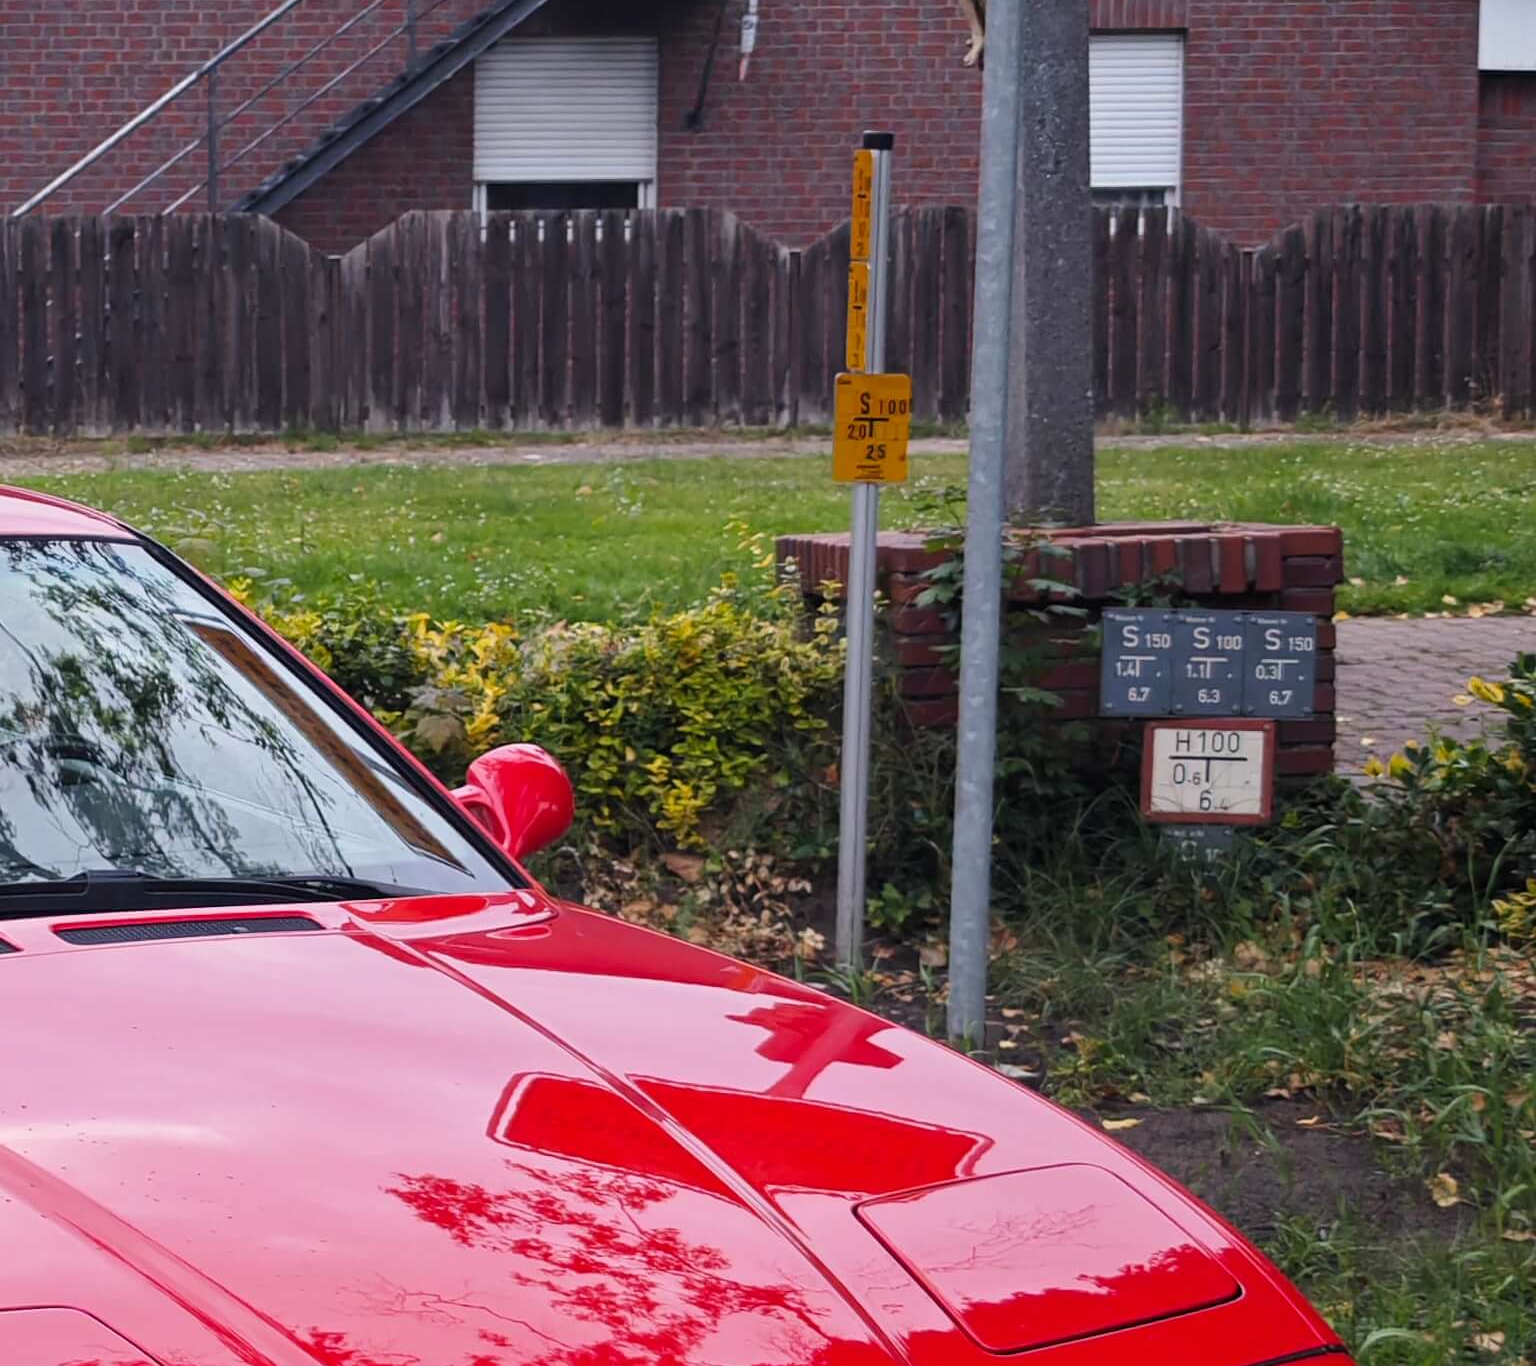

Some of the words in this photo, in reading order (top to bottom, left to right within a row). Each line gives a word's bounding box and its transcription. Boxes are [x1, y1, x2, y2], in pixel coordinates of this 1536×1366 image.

[860, 392, 870, 414] S
[1122, 625, 1140, 648] S
[1145, 633, 1171, 649] 150
[1192, 627, 1211, 649] S
[1216, 635, 1242, 650] 100
[1264, 628, 1282, 650] S
[1288, 636, 1313, 652] 150
[1128, 687, 1151, 702] 6.7
[1197, 689, 1221, 703] 6.3
[1269, 690, 1293, 705] 6.7
